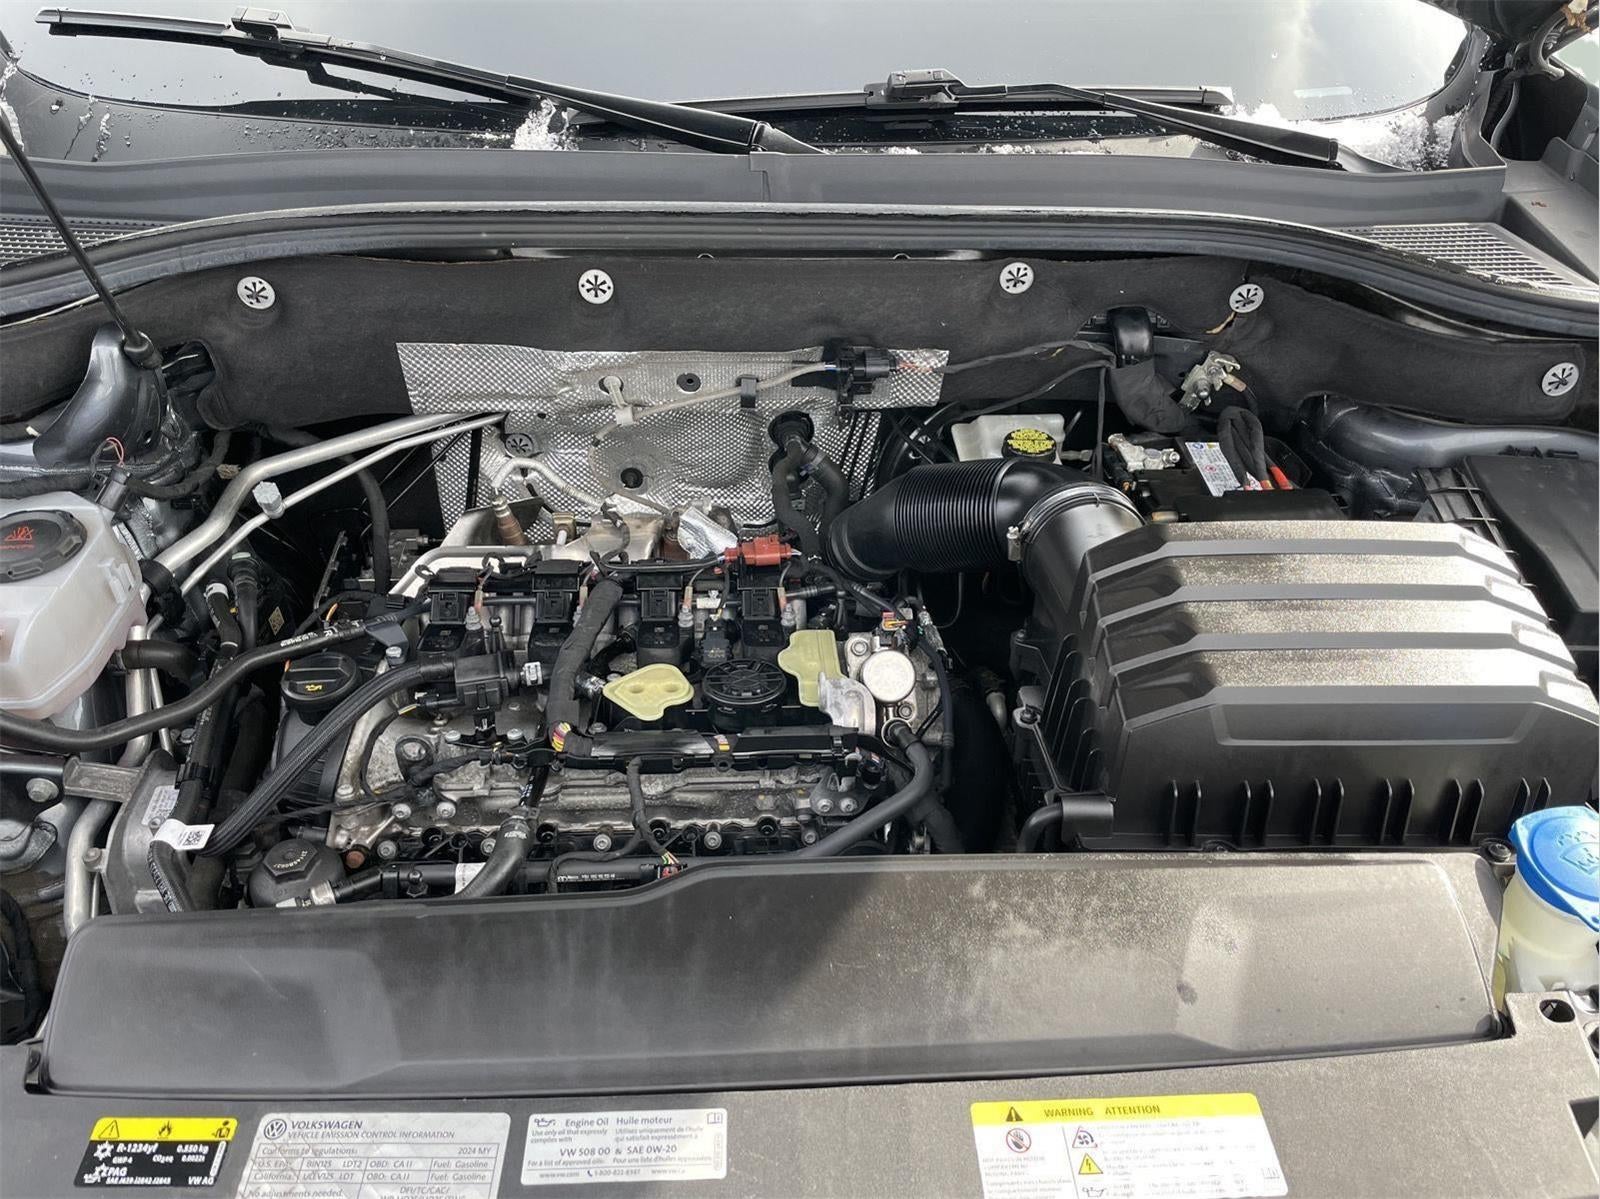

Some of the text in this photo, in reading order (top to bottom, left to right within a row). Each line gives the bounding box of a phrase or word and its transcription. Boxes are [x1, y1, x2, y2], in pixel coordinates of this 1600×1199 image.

[1044, 1105, 1160, 1118] WARNING ATTENTION
[291, 1120, 363, 1129] VOLKSWAGEN
[565, 1118, 609, 1128] Engine Oil
[616, 1116, 640, 1125] Huile
[288, 1131, 320, 1139] VEHICLE
[321, 1131, 360, 1139] EMISSION
[399, 1131, 455, 1139] INFORMATION
[116, 1143, 158, 1153] R-1234yf
[200, 1144, 209, 1154] kg
[560, 1148, 576, 1157] VW
[579, 1148, 595, 1156] 508
[598, 1147, 610, 1155] 00
[627, 1146, 644, 1154] SAE
[646, 1144, 677, 1154] 0W-20
[343, 1160, 362, 1168] LDT2
[455, 1160, 488, 1168] Gasoline
[108, 1167, 128, 1176] PAG
[188, 1177, 202, 1185] VW
[452, 1173, 486, 1181] Gasoline
